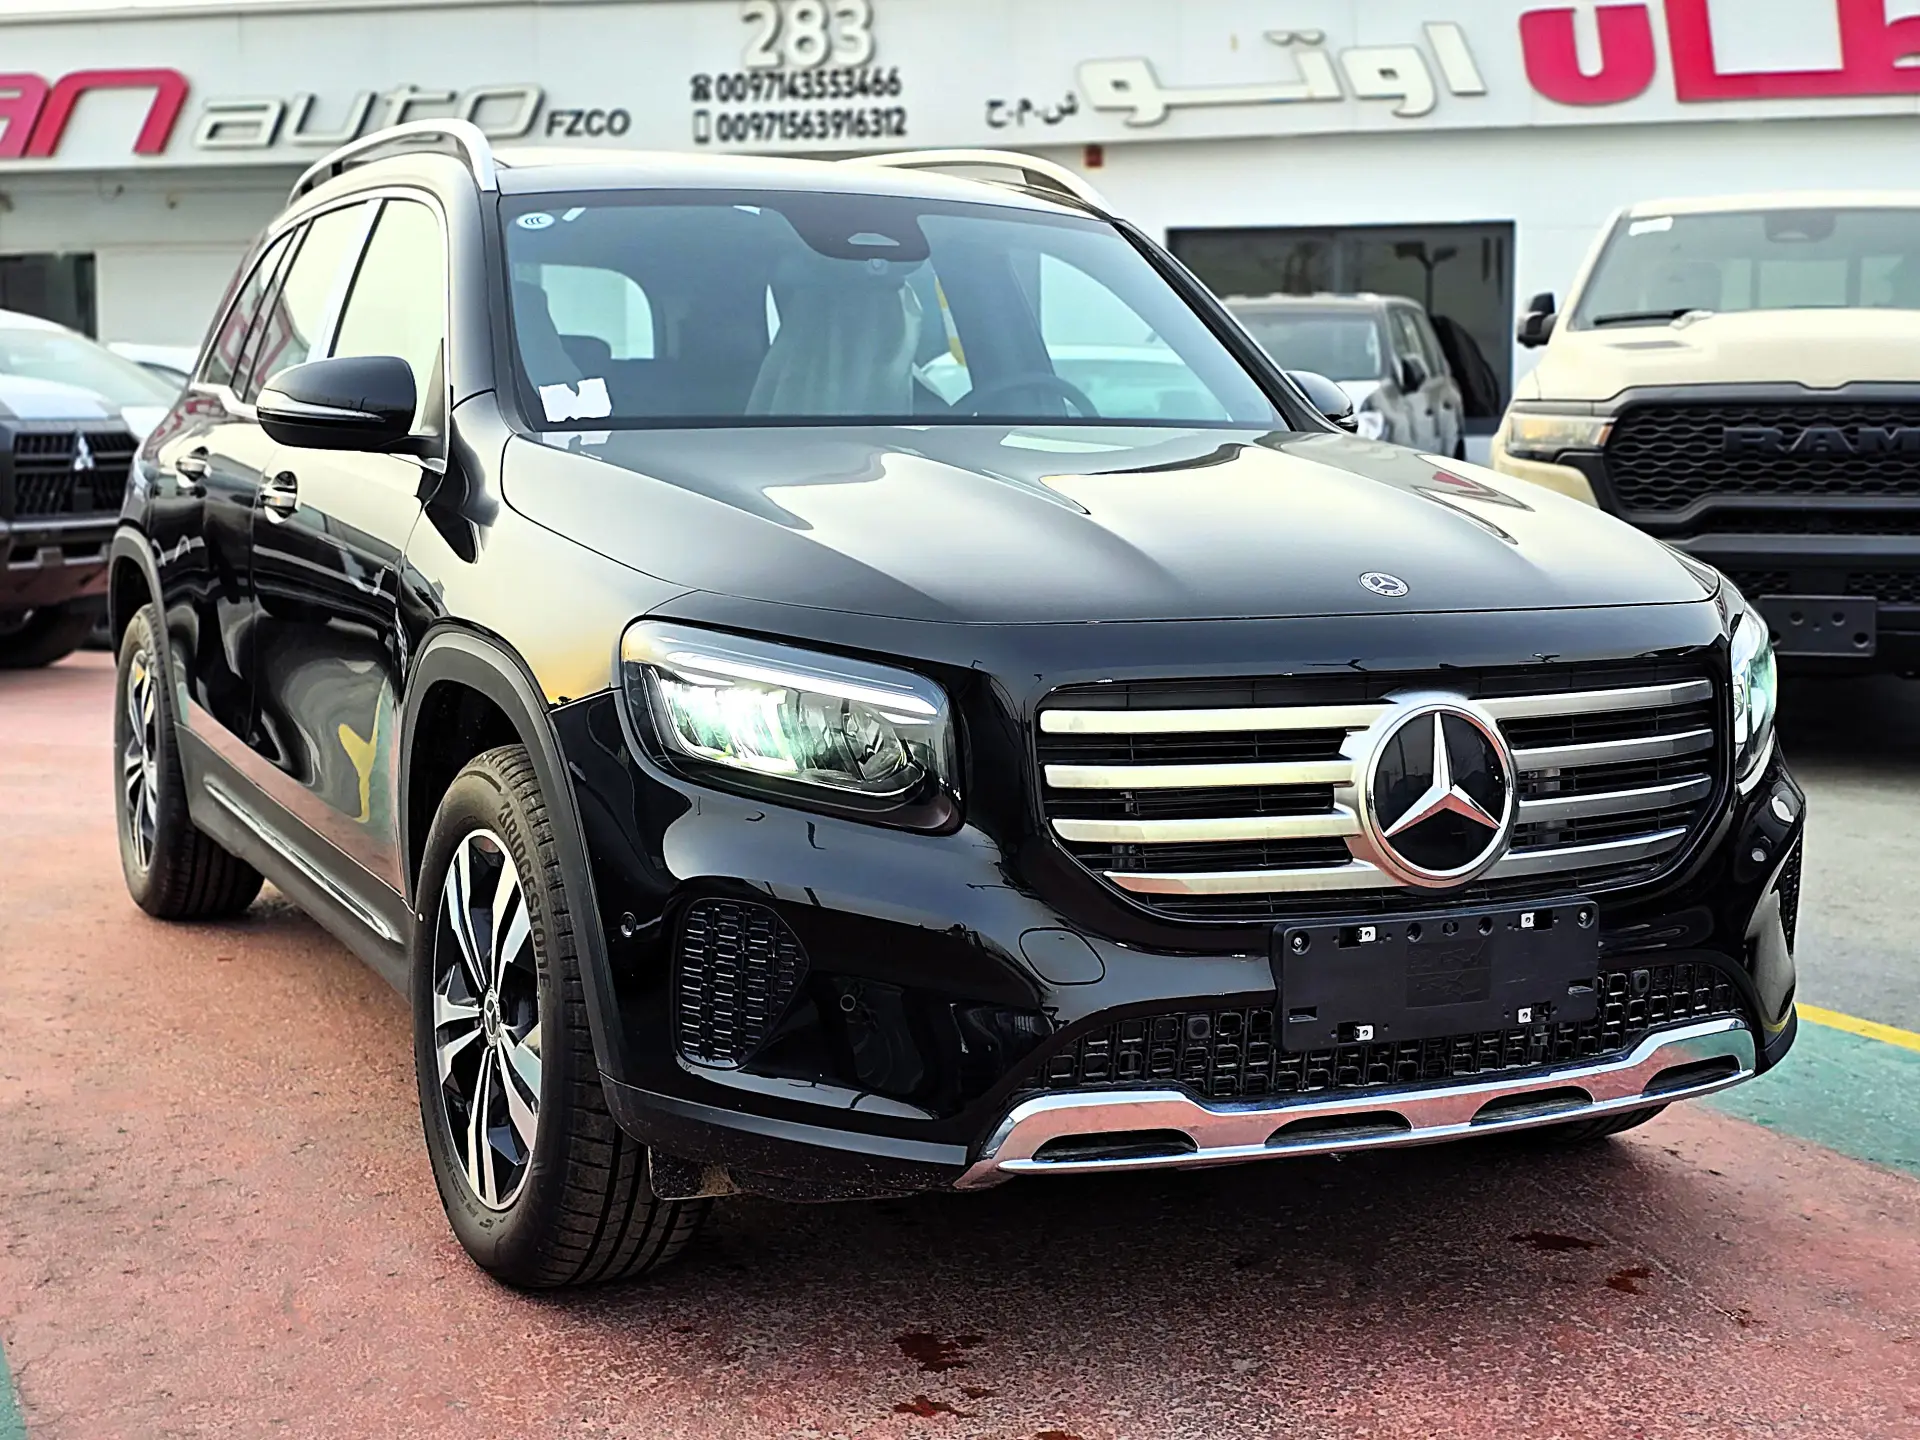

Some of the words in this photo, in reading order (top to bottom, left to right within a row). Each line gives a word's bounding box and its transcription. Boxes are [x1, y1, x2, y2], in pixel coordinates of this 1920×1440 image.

[741, 0, 875, 69] 283
[715, 66, 902, 102] 0097143553466
[195, 81, 547, 150] auto
[545, 109, 632, 138] FZCO
[715, 106, 907, 142] 00971563916312
[1723, 426, 1920, 453] RAM
[498, 801, 552, 989] BRIDGESTONE
